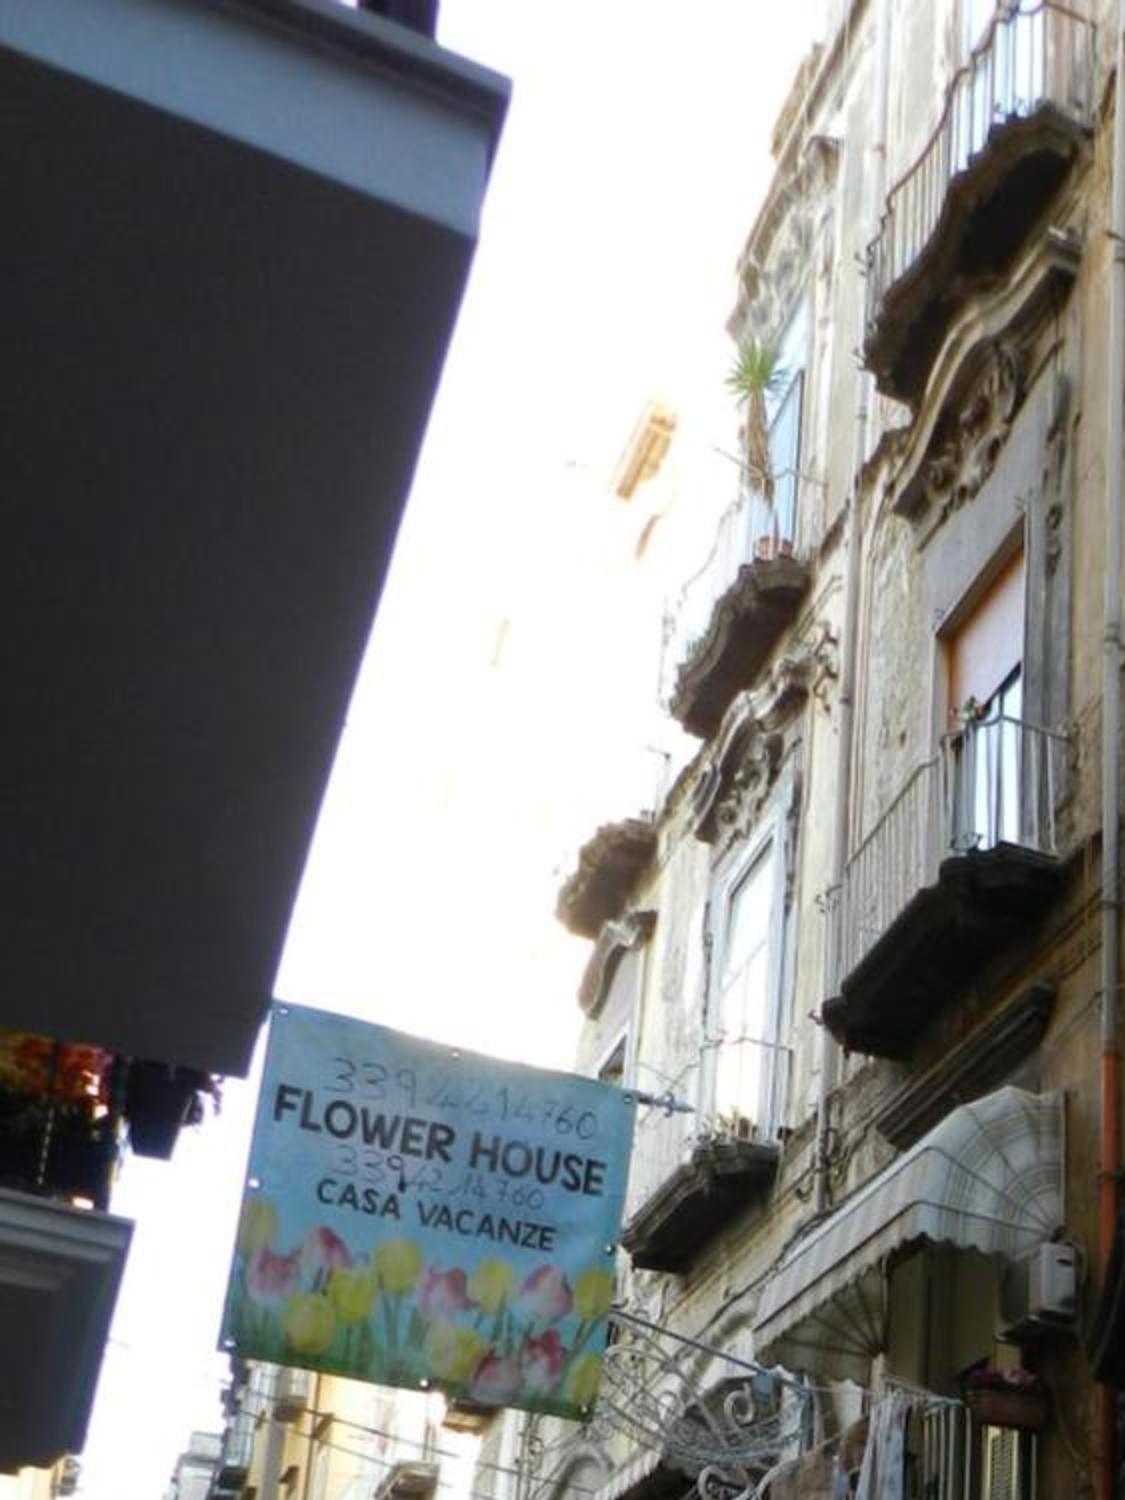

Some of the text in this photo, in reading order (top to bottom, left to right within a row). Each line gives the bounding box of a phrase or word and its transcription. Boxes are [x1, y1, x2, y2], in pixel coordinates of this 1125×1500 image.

[272, 1084, 608, 1197] FLOWER HOUSE
[317, 1178, 559, 1253] CASA VACANZE
